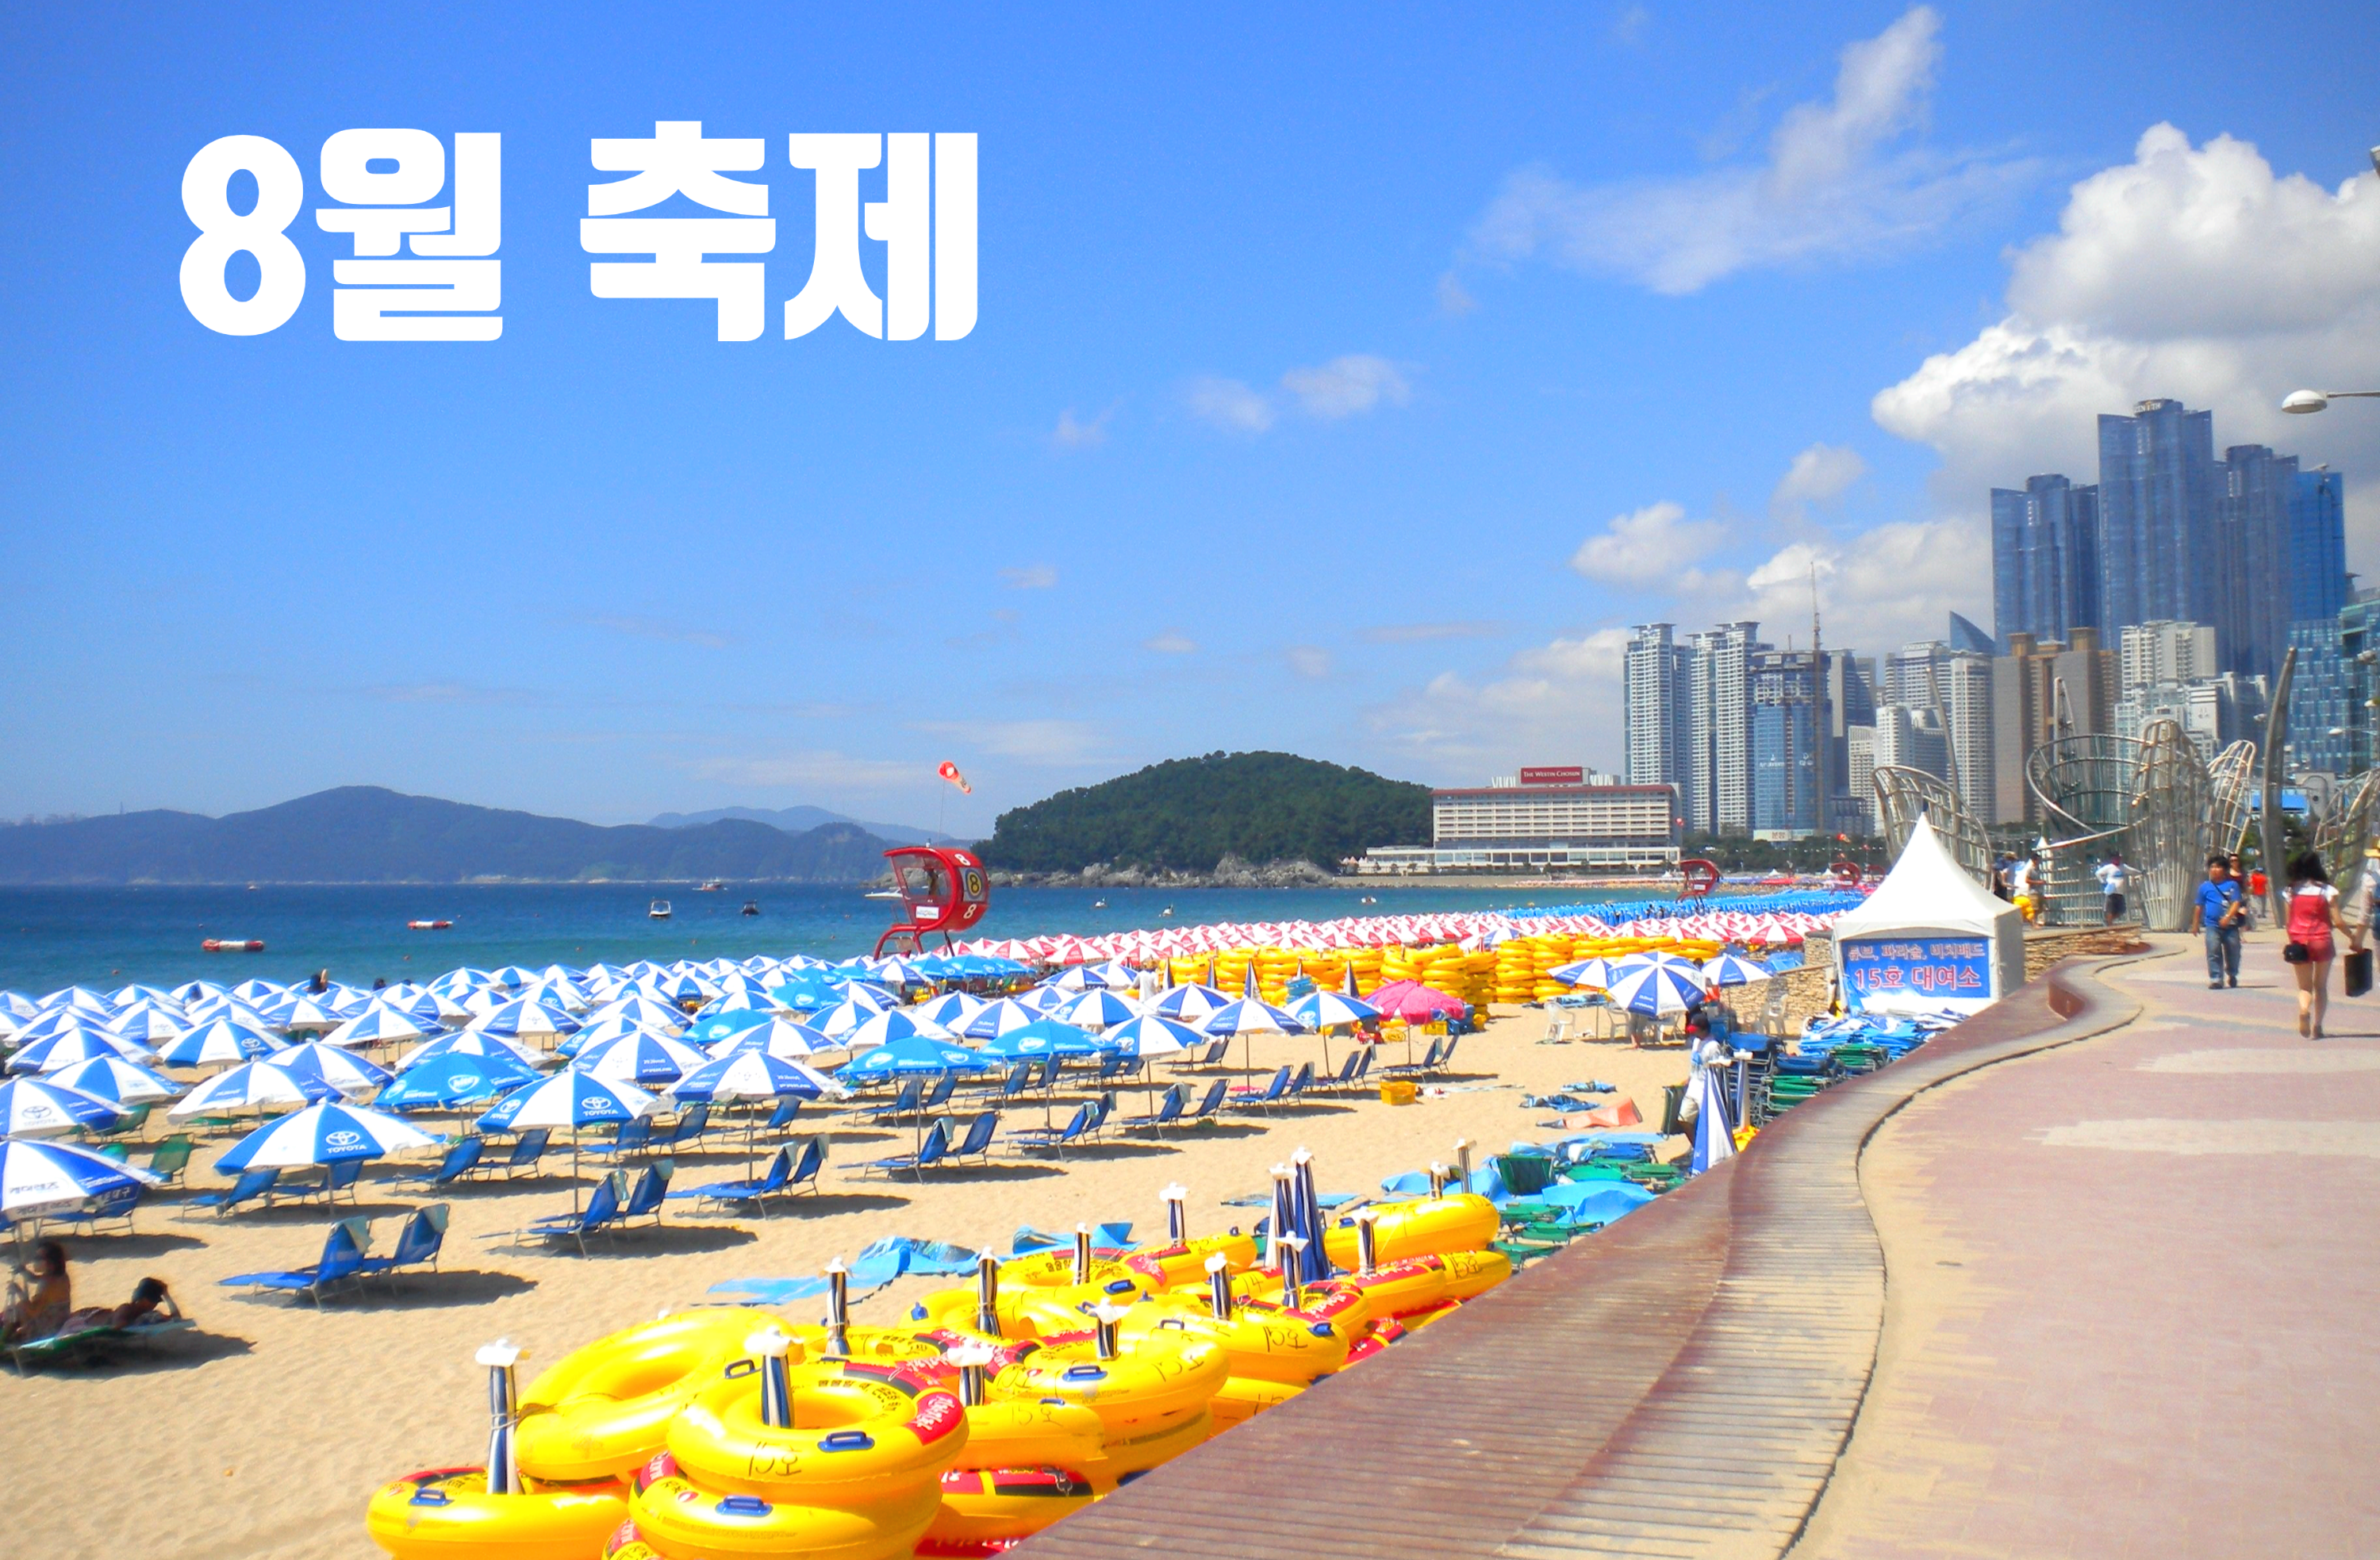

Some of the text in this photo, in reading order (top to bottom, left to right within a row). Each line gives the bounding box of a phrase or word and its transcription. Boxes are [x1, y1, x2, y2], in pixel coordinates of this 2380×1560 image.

[954, 853, 971, 866] 8
[969, 874, 981, 894] 8
[963, 904, 977, 919] 8
[1881, 943, 1927, 961] 파라솔,
[1854, 965, 1982, 991] 15호 대여소
[325, 1143, 367, 1155] TOYOTA
